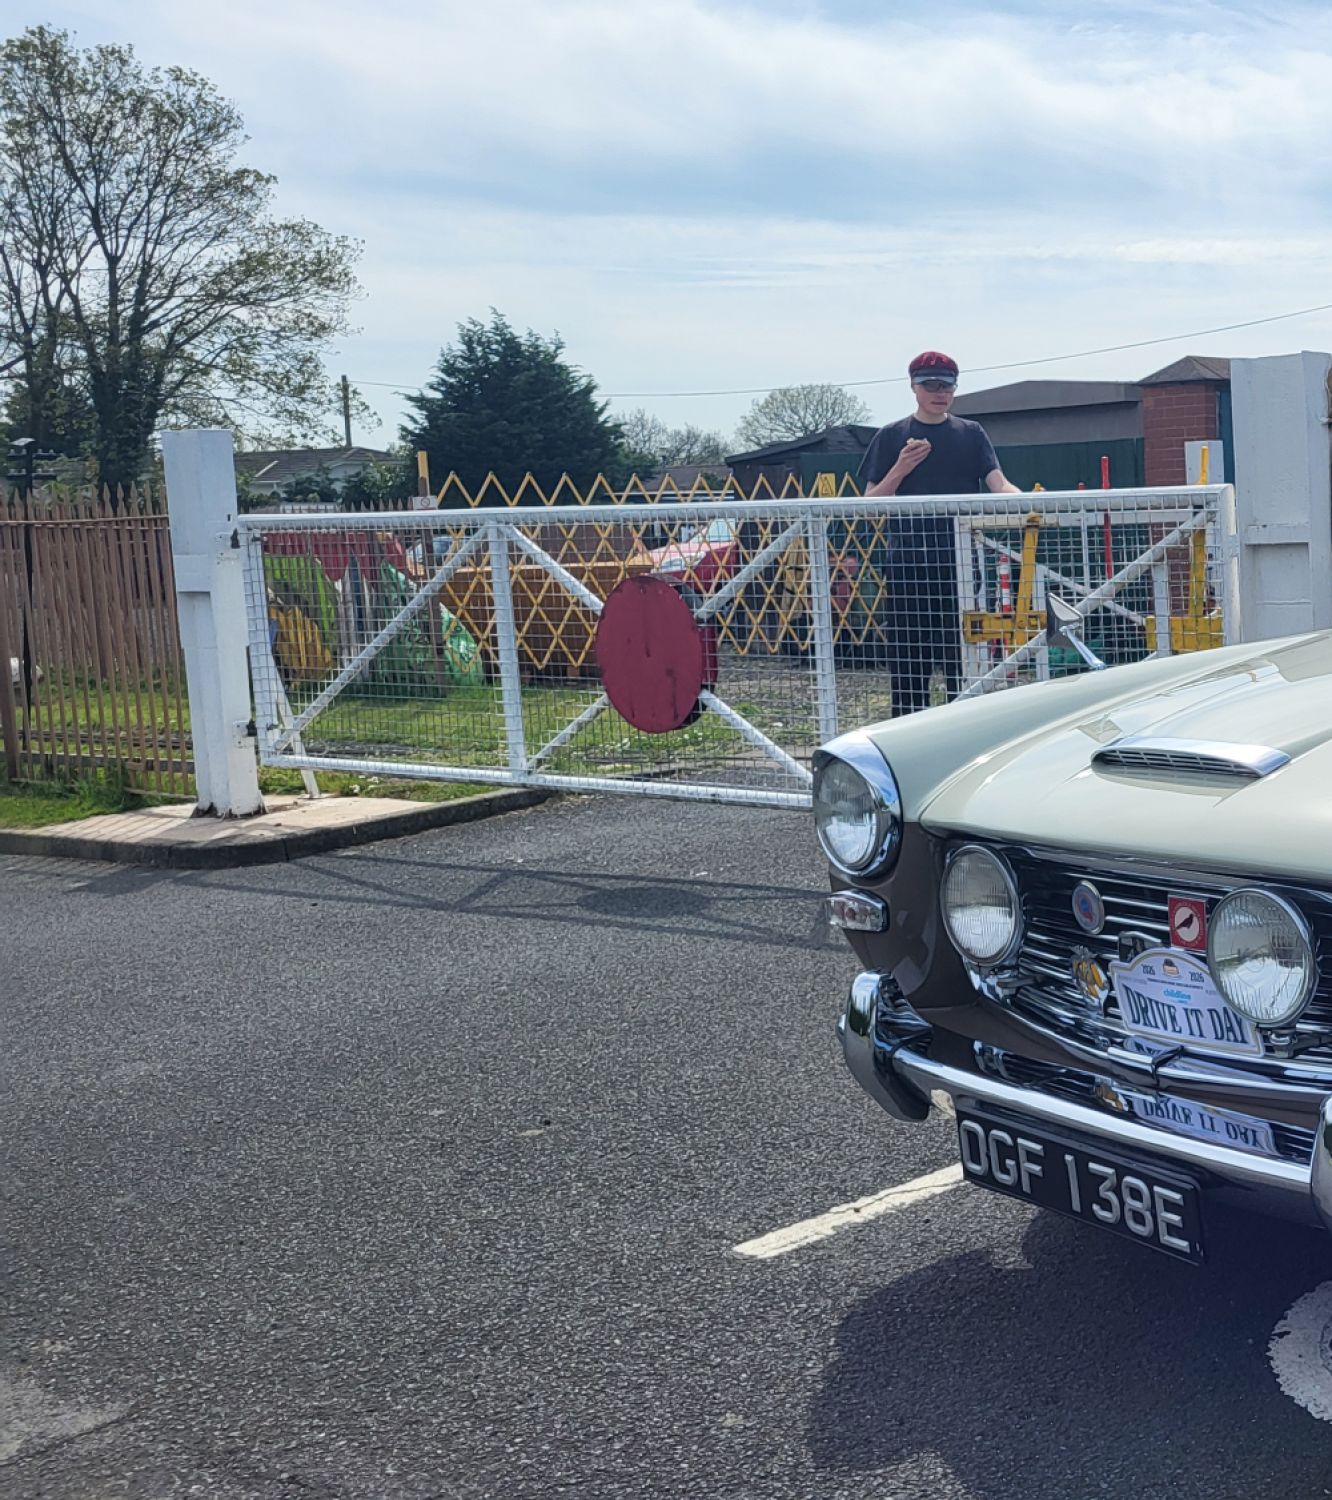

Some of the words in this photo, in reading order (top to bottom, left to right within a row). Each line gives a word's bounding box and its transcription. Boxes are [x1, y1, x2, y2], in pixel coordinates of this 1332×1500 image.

[1122, 984, 1182, 1034] DRIVE
[1183, 1007, 1207, 1039] IT
[1207, 1006, 1249, 1044] DAY
[1064, 1153, 1191, 1254] 138E
